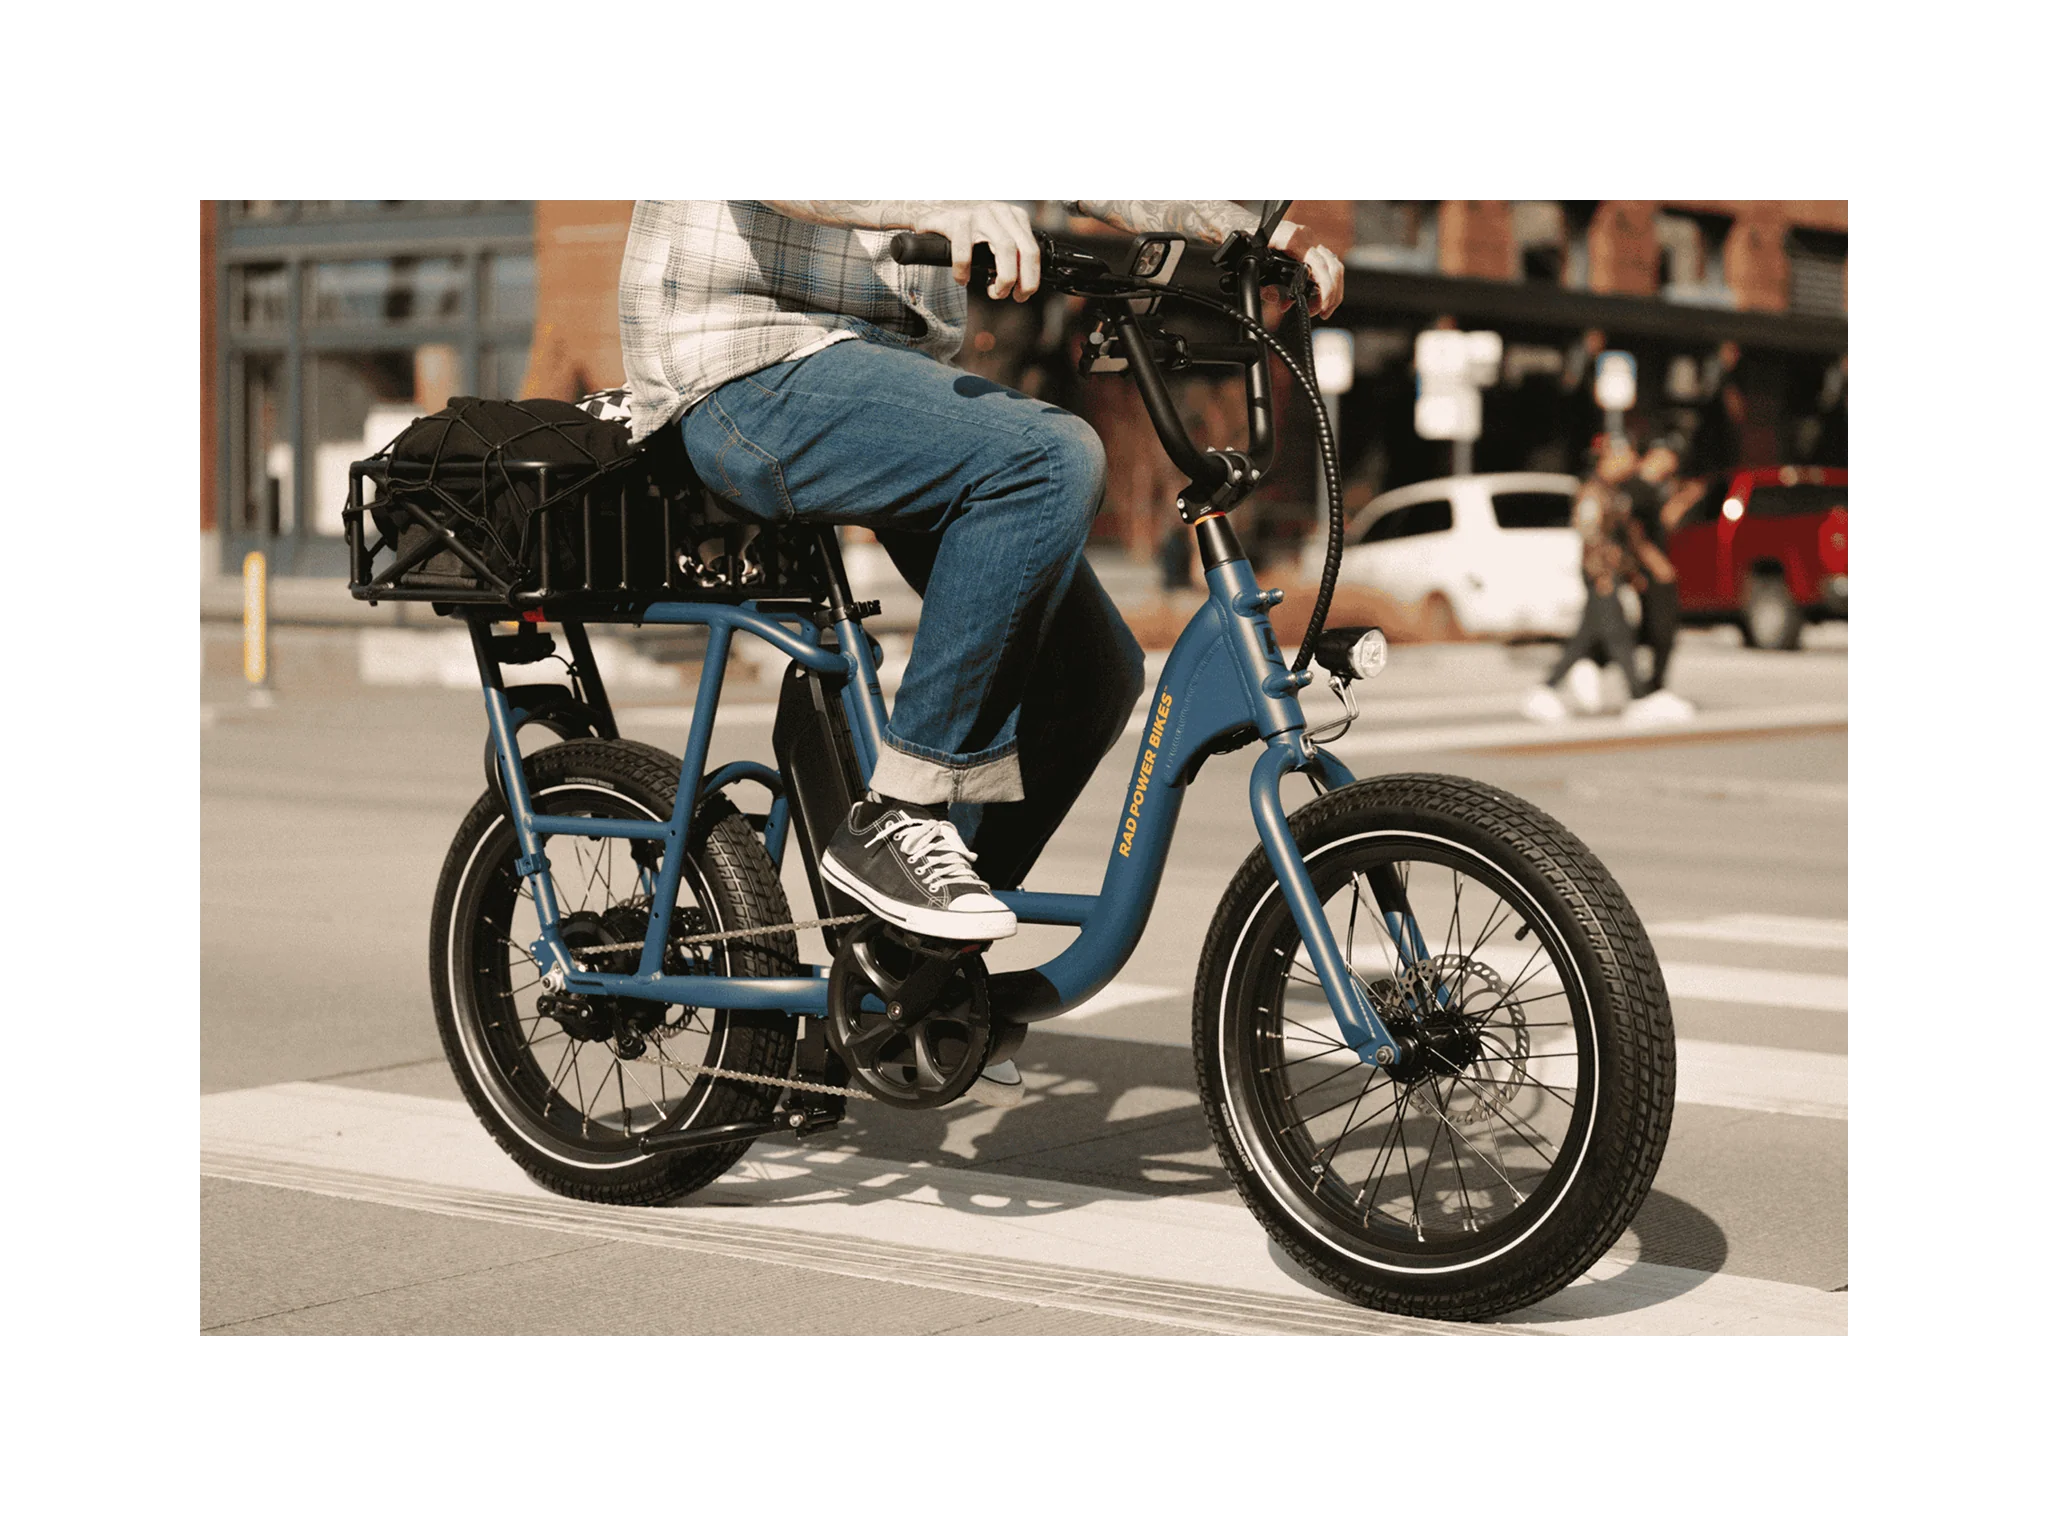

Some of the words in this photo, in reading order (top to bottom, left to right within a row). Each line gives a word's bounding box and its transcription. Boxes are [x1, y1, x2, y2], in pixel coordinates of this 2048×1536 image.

[1119, 817, 1137, 858] RAD
[1129, 749, 1157, 818] POWER
[1148, 692, 1173, 749] BIKES
